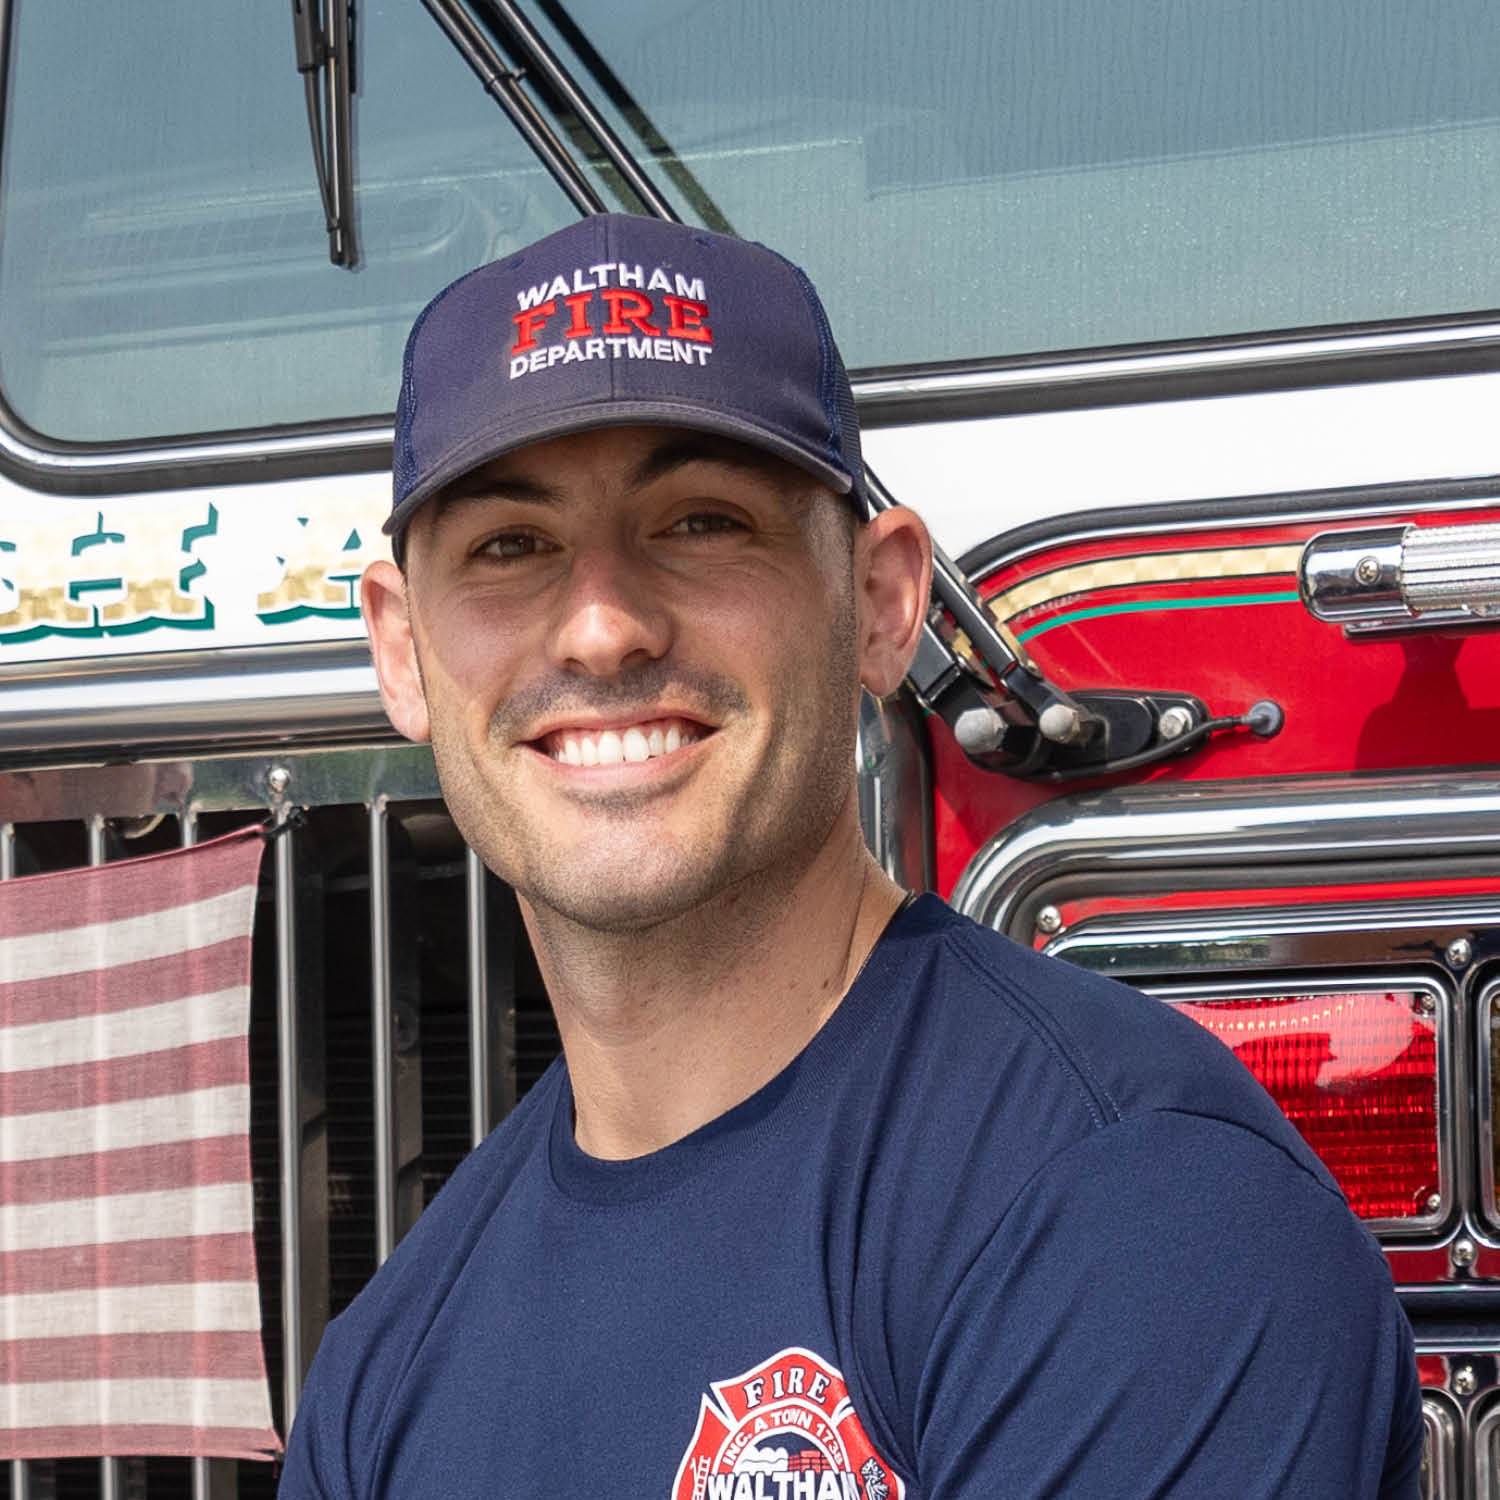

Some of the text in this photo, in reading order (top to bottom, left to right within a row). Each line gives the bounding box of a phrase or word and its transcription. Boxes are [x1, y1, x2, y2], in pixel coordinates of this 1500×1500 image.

[516, 262, 707, 312] WALTHAM
[511, 288, 713, 356] FIRE
[509, 336, 713, 381] DEPARTMENT
[743, 1366, 831, 1409] FIRE
[722, 1431, 753, 1466] INC.
[754, 1417, 769, 1433] A
[770, 1408, 813, 1430] TOWN
